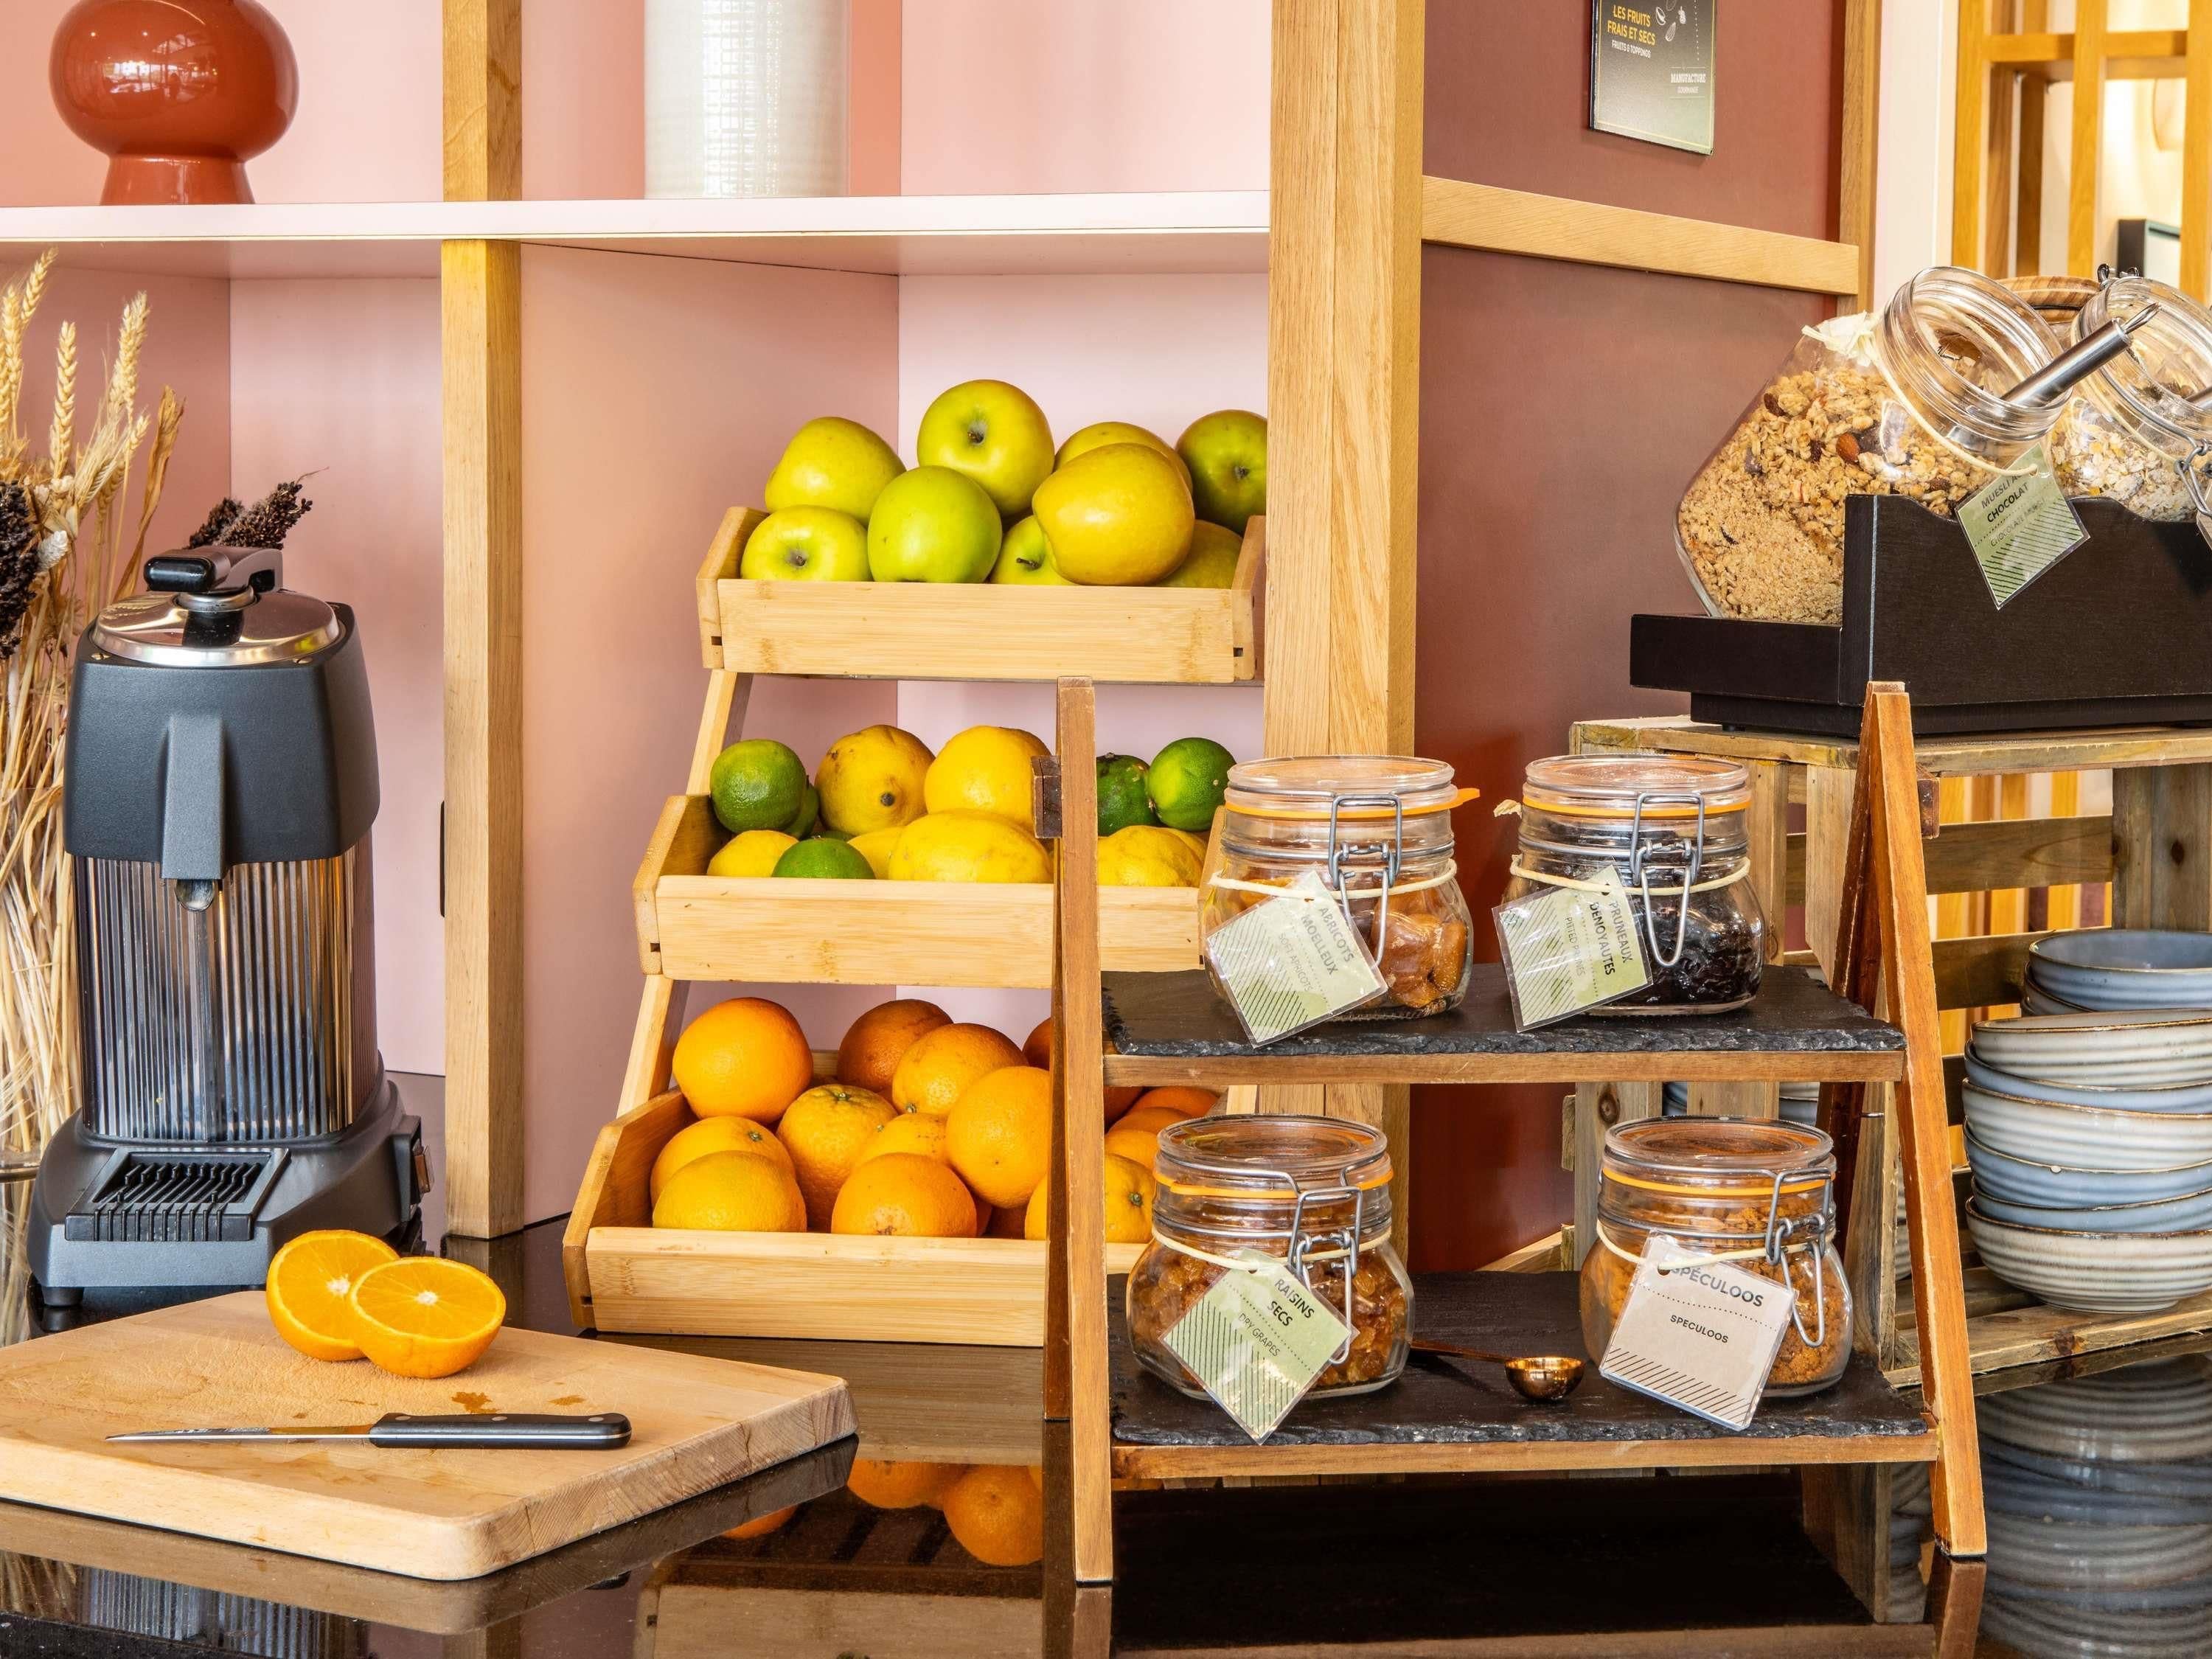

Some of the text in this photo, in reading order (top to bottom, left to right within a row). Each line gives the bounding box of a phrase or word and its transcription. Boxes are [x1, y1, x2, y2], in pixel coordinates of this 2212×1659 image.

[1613, 4, 1651, 27] LES FRUITS
[1607, 20, 1655, 46] FRAIS ET SECS
[1612, 40, 1627, 52] FRUITS
[1981, 479, 2011, 509] MUESLI
[1987, 483, 2029, 523] CHOCOLAT
[1301, 914, 1338, 975] MOELLEUX
[1319, 908, 1354, 962] ABRICOTS
[1565, 917, 1579, 944] PITTED
[1610, 901, 1634, 963] PRUNEAUX
[1279, 933, 1313, 992] SOFT APRICOTS
[1267, 1301, 1293, 1326] SECS
[1275, 1279, 1315, 1318] RAISINS
[1238, 1312, 1281, 1357] DRY GRAPES
[1670, 1315, 1729, 1343] SPECULOOS
